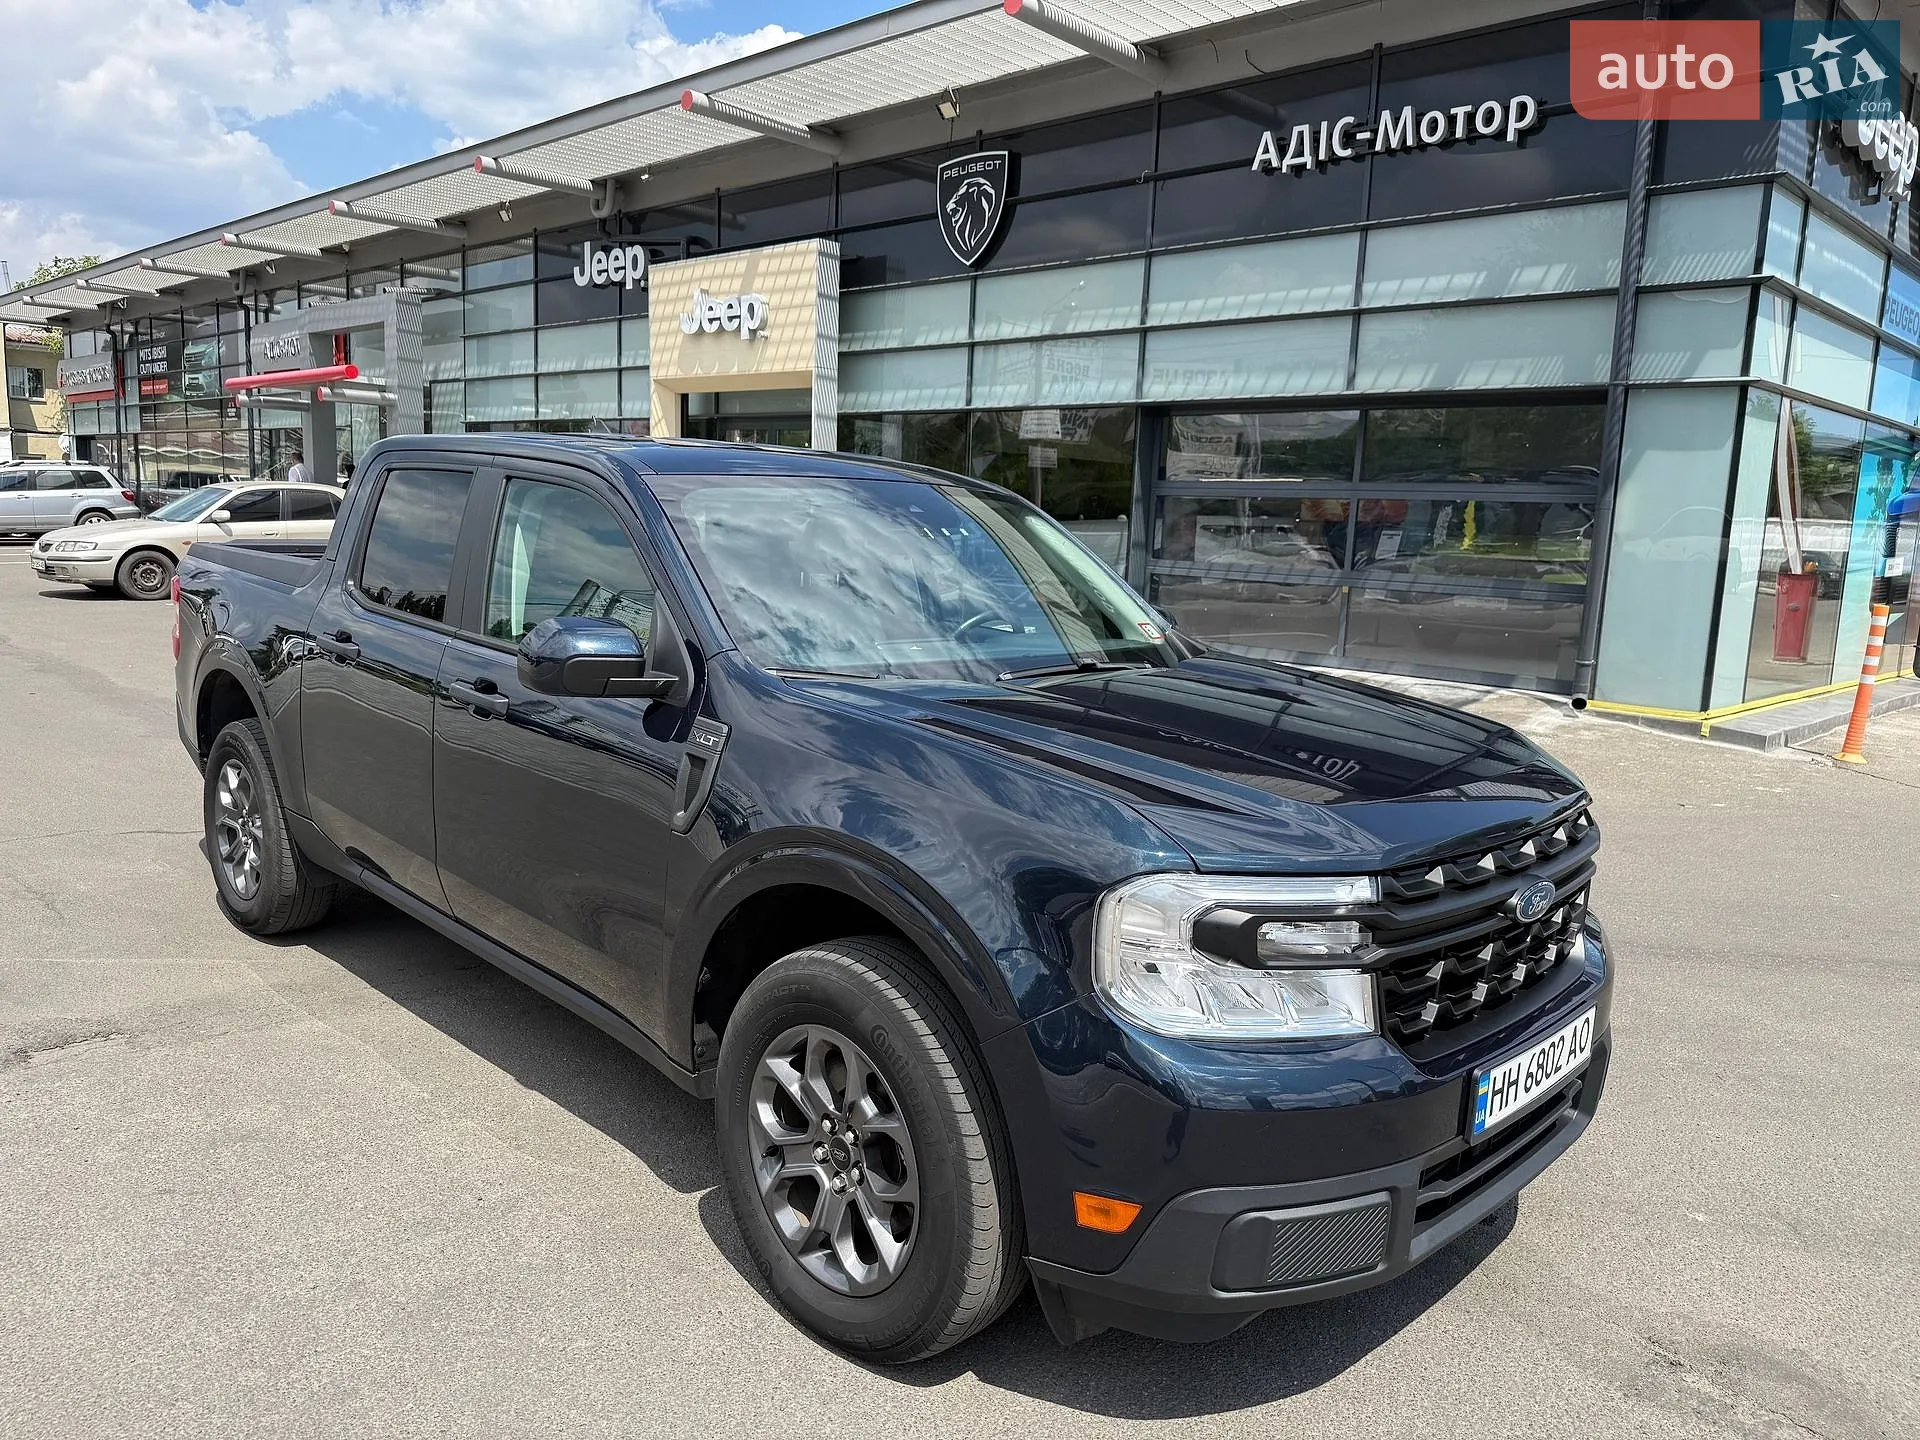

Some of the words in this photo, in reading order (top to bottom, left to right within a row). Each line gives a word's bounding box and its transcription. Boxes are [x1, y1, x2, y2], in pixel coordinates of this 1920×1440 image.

[1251, 94, 1537, 173] АДІС-Мотор
[943, 160, 1002, 180] PEUGEOT
[573, 241, 645, 290] Jeep
[680, 287, 769, 340] Jeep
[139, 345, 167, 361] MITSBISHI
[692, 730, 719, 746] XLT
[1528, 889, 1551, 915] Ford
[1489, 1062, 1521, 1117] HH
[1524, 1035, 1565, 1094] 6802
[1566, 1017, 1590, 1066] AO
[1475, 1109, 1485, 1125] UA
